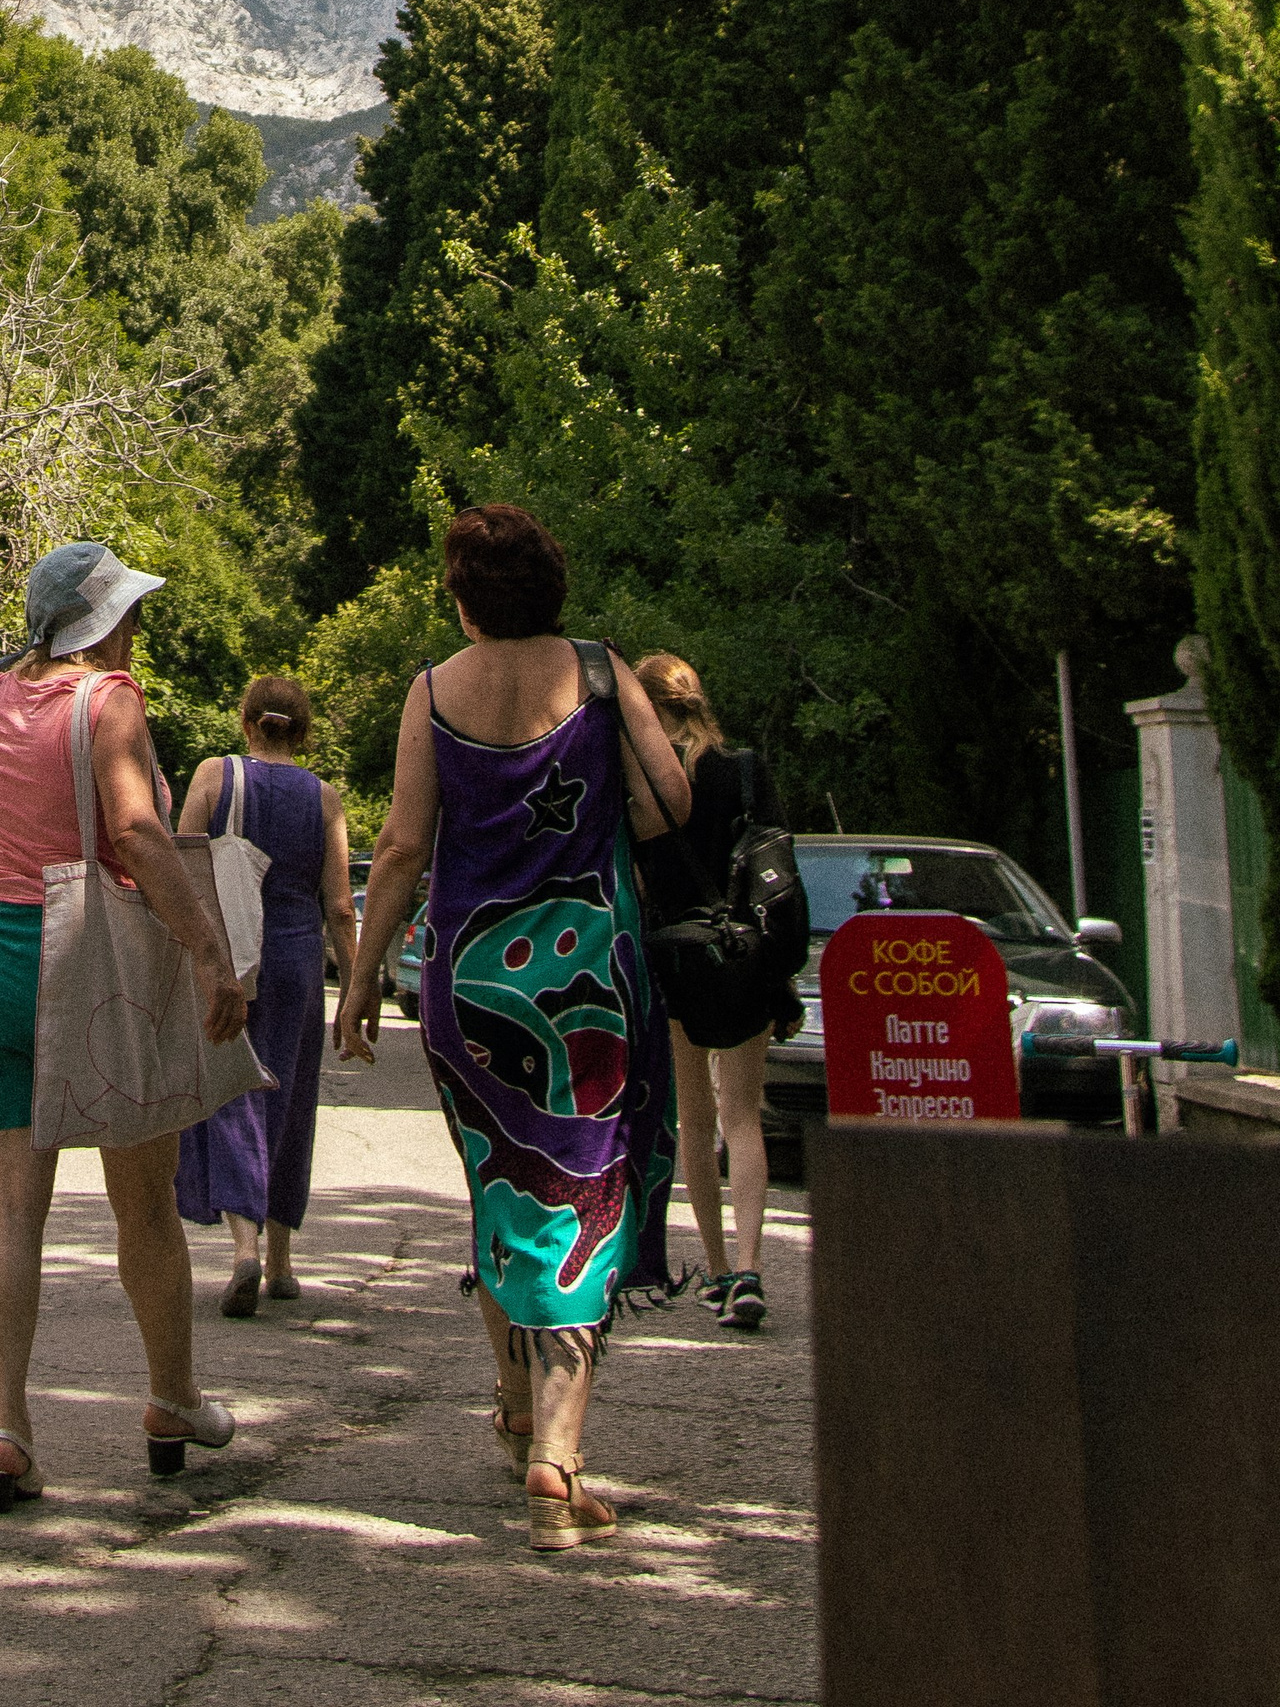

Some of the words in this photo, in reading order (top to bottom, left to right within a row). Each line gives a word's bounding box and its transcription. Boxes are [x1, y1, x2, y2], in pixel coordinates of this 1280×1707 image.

[872, 939, 953, 966] КОФЕ
[849, 970, 868, 995] С
[874, 968, 980, 996] СОБОЙ
[870, 1050, 971, 1087] Капучино
[873, 1087, 975, 1123] Эспрессо
